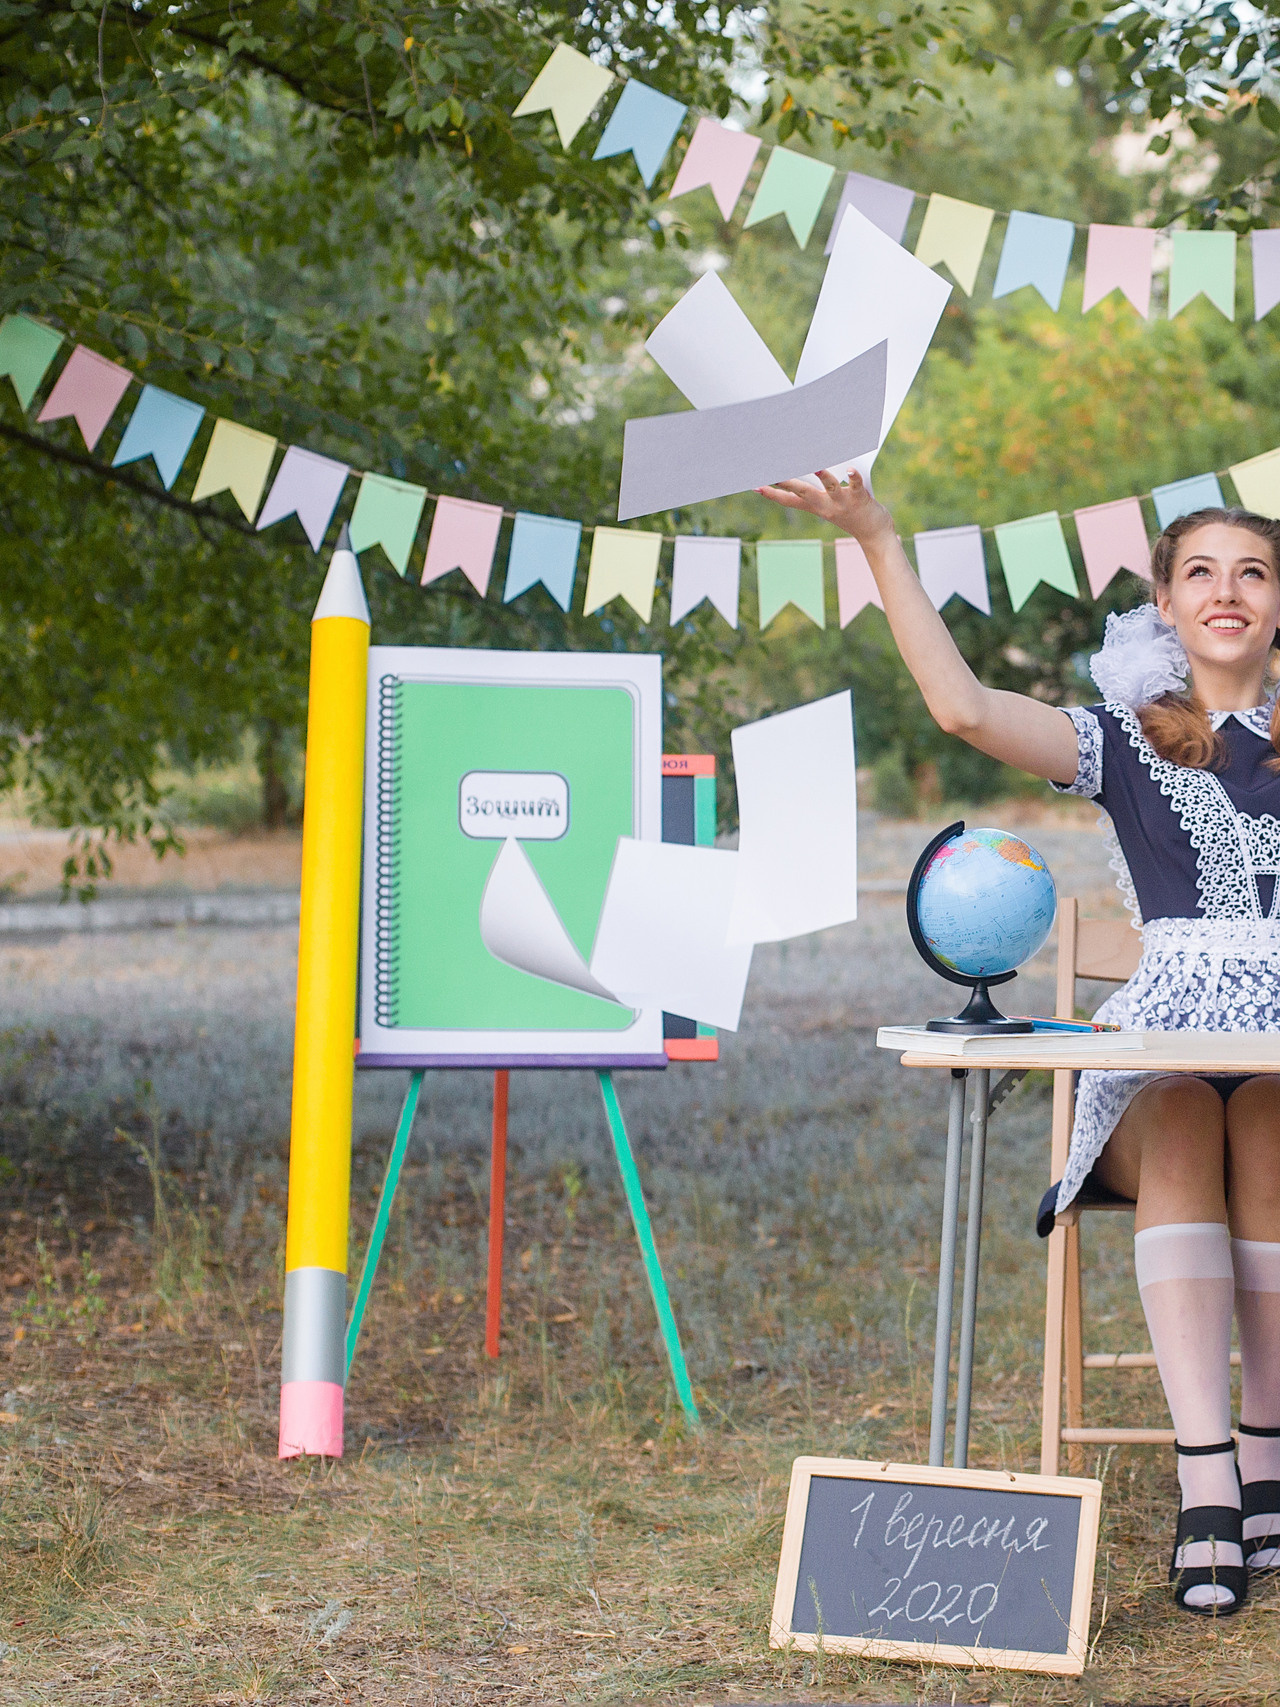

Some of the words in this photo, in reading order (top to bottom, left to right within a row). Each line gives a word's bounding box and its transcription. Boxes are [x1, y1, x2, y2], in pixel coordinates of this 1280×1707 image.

[466, 796, 560, 821] Зошит
[850, 1492, 875, 1549] 1
[884, 1490, 1051, 1579] вересня
[868, 1577, 999, 1628] 2020
